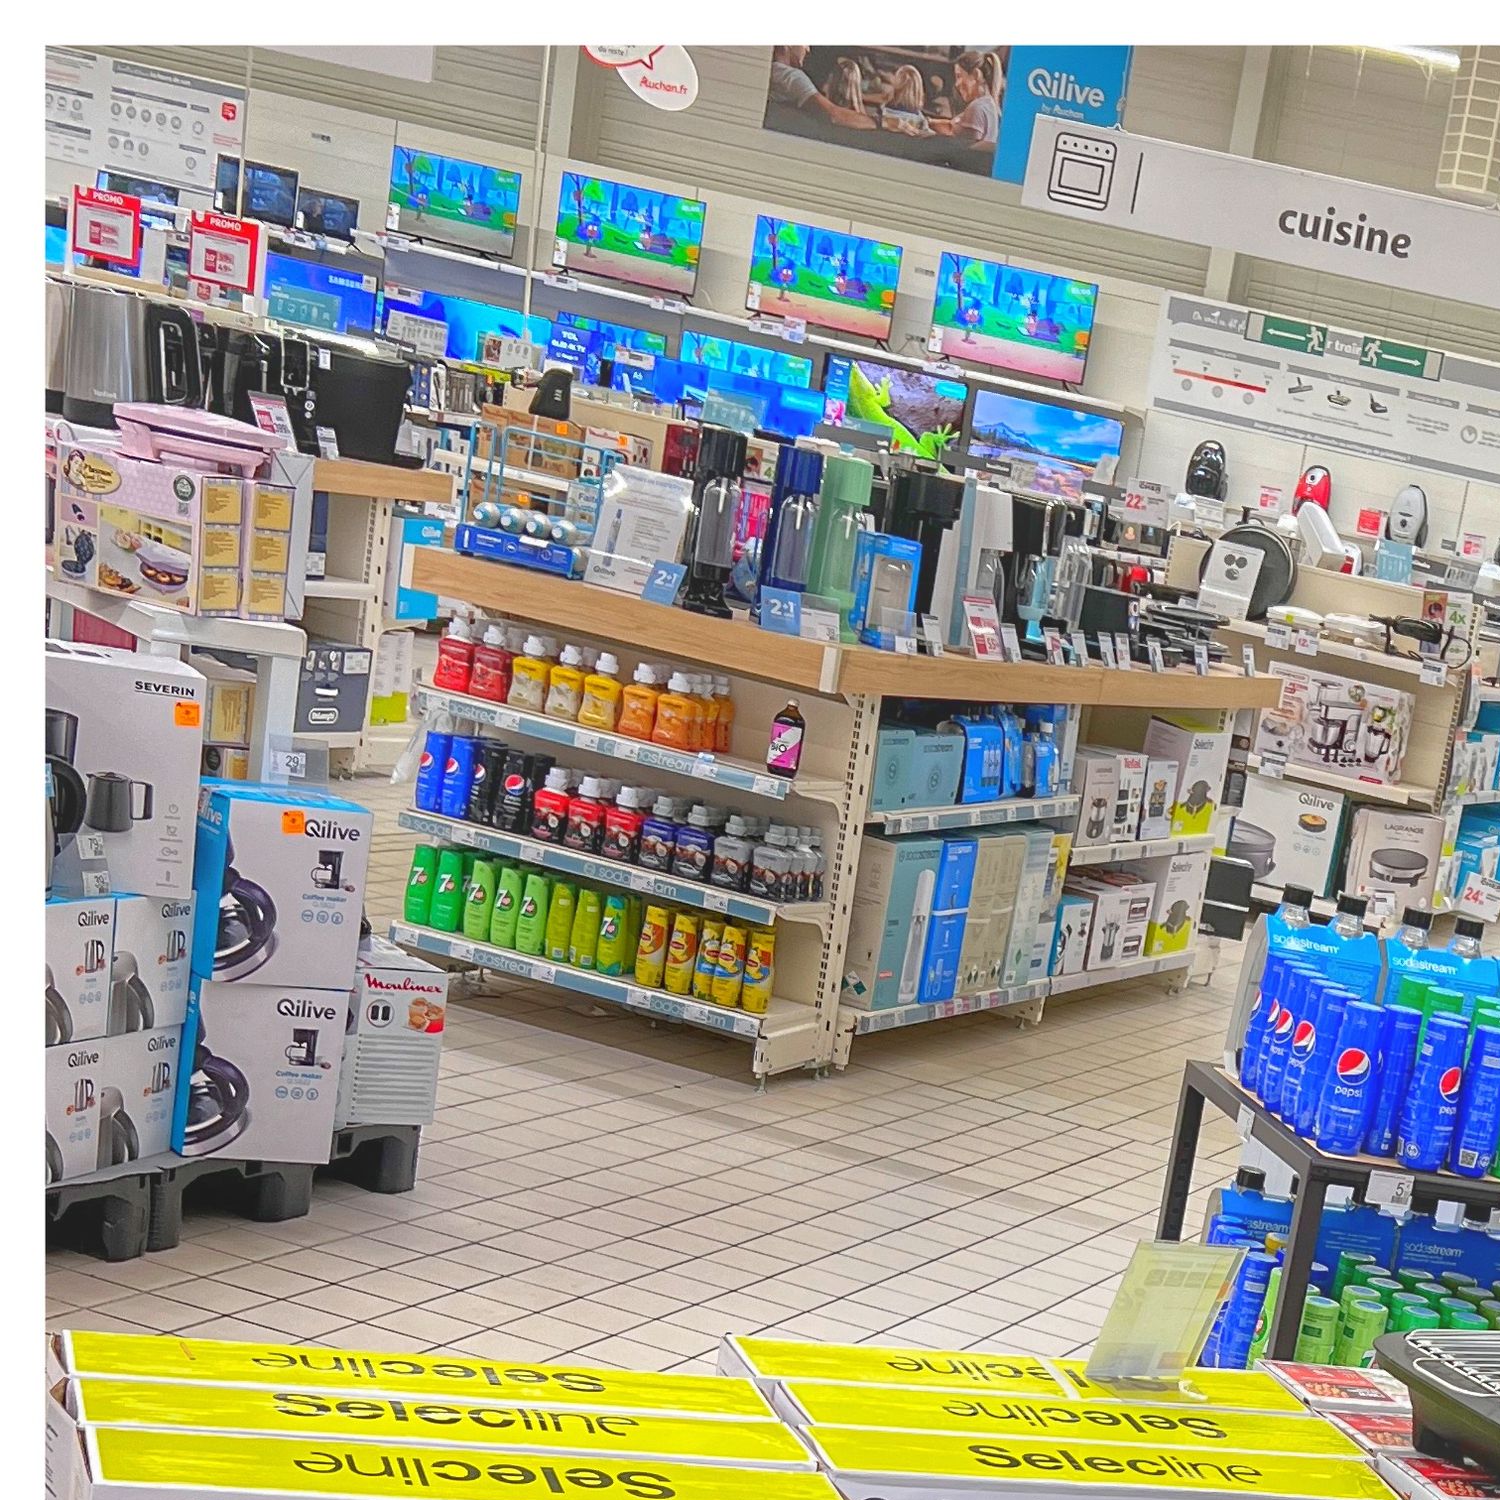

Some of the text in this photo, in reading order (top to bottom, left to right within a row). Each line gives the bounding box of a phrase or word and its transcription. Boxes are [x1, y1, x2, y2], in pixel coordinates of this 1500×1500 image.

[639, 76, 689, 96] Auchan.fr
[1027, 67, 1105, 109] Qilive
[92, 191, 124, 206] PROMO
[209, 217, 242, 232] PROMO
[1277, 205, 1413, 261] cuisine
[135, 680, 195, 697] SEVERIN
[1298, 791, 1336, 814] Qilive
[304, 818, 361, 842] Qilive
[77, 911, 110, 927] Qilive
[161, 902, 192, 919] Qilive
[1272, 932, 1339, 955] sodastream
[1392, 955, 1458, 976] sodastream
[277, 998, 337, 1021] Qilive
[147, 1036, 177, 1053] Qilive
[67, 1050, 99, 1068] Qilive
[251, 1351, 607, 1394] Selecline
[272, 1391, 640, 1438] Selecline
[942, 1398, 1228, 1441] Selecline
[293, 1450, 677, 1500] Selecline
[967, 1444, 1264, 1486] Selecline
